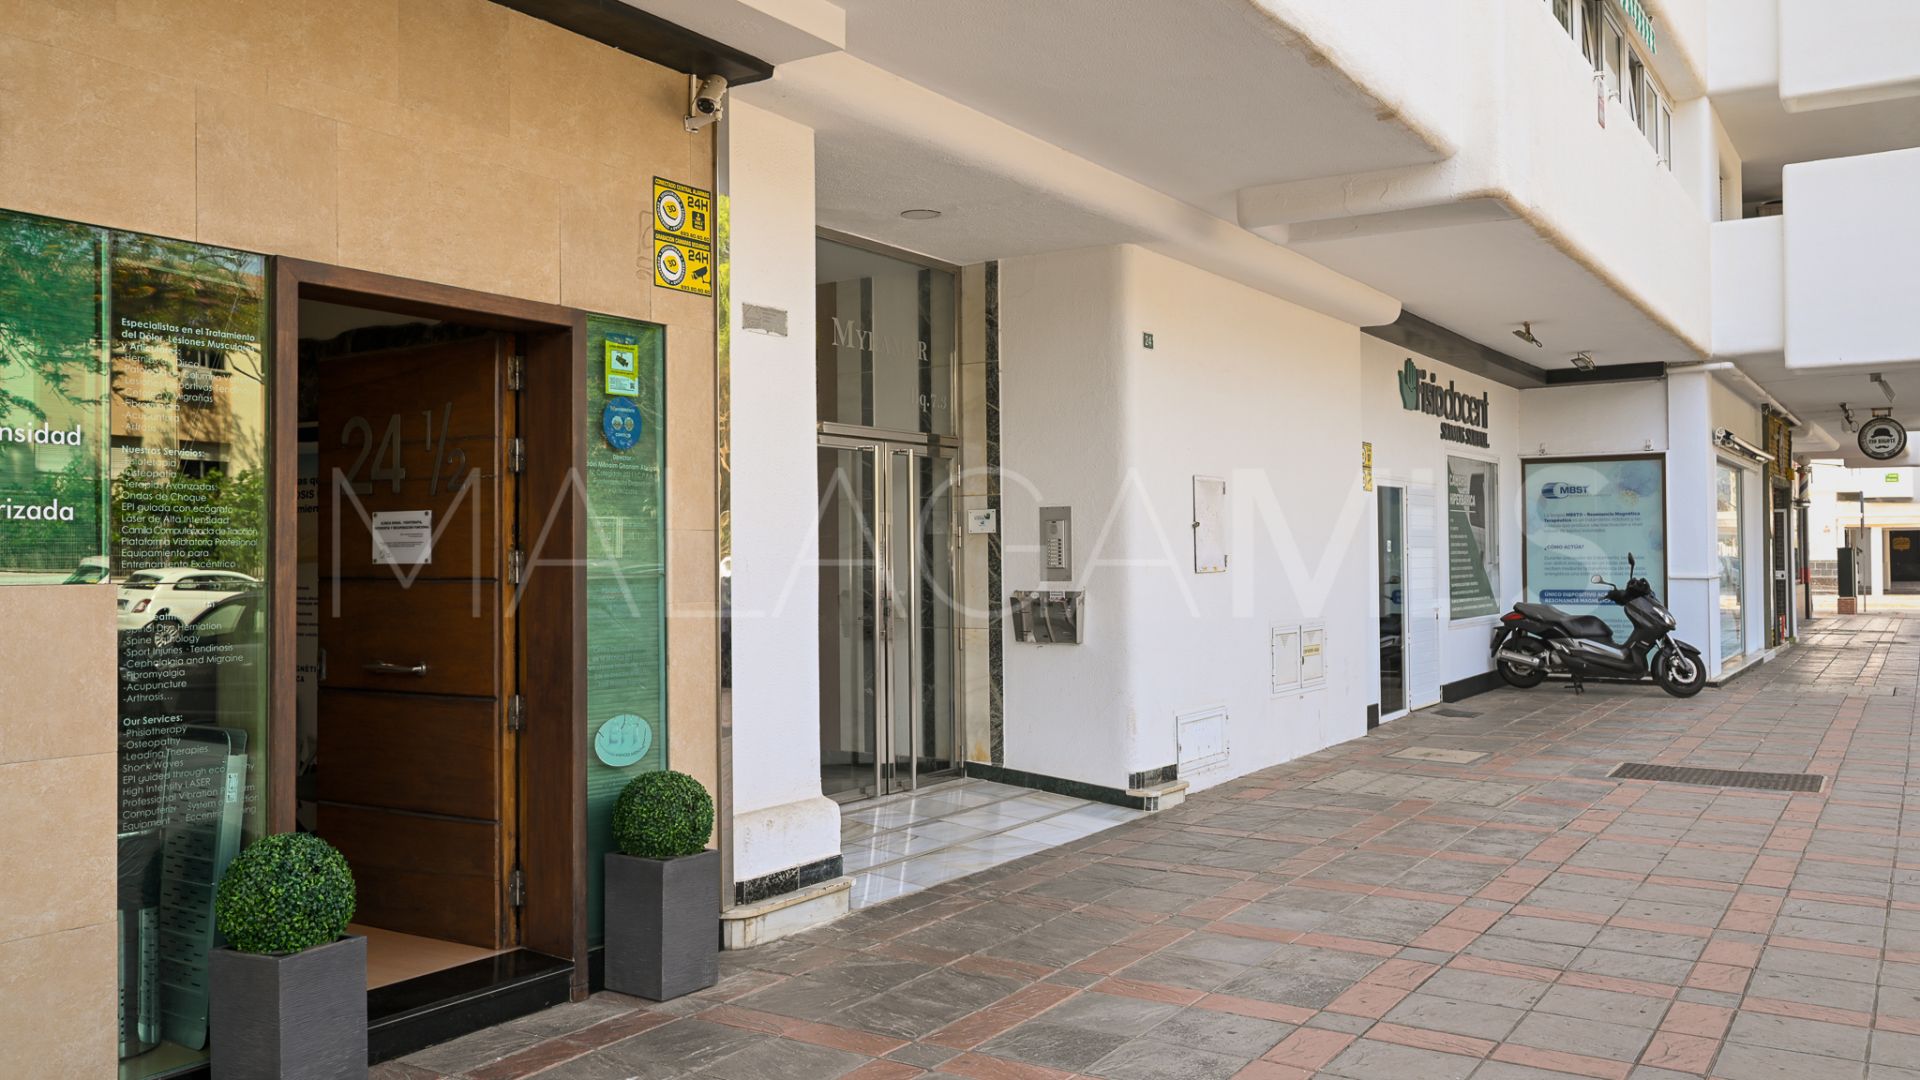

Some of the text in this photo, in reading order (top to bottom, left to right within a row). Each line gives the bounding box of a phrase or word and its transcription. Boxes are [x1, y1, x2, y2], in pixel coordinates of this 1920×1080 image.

[687, 195, 709, 212] 24H
[688, 249, 709, 265] 24H
[121, 318, 256, 342] Especialistas en el Tratamiento
[121, 329, 137, 339] del
[121, 445, 162, 454] Nuestros
[340, 413, 406, 496] 24
[1560, 485, 1589, 495] MBST
[121, 491, 207, 503] Ondas de Choque
[121, 503, 135, 512] EPI
[137, 503, 171, 515] guiada
[173, 505, 191, 513] con
[148, 514, 161, 523] de
[163, 514, 182, 524] Alta
[183, 515, 230, 525] Intensidad
[121, 548, 210, 559] Equipamiento para
[121, 560, 190, 569] Entrenamiento
[152, 645, 183, 657] Injuries
[186, 655, 205, 665] and
[206, 653, 244, 665] Migraine
[123, 714, 183, 727] Our Services:
[123, 758, 184, 773] Shock Waves
[123, 775, 136, 785] EPI
[138, 771, 171, 784] guided
[172, 766, 207, 778] through
[123, 785, 144, 797] High
[185, 777, 211, 788] LASER
[123, 794, 176, 808] Professional
[123, 816, 170, 832] Equipment
